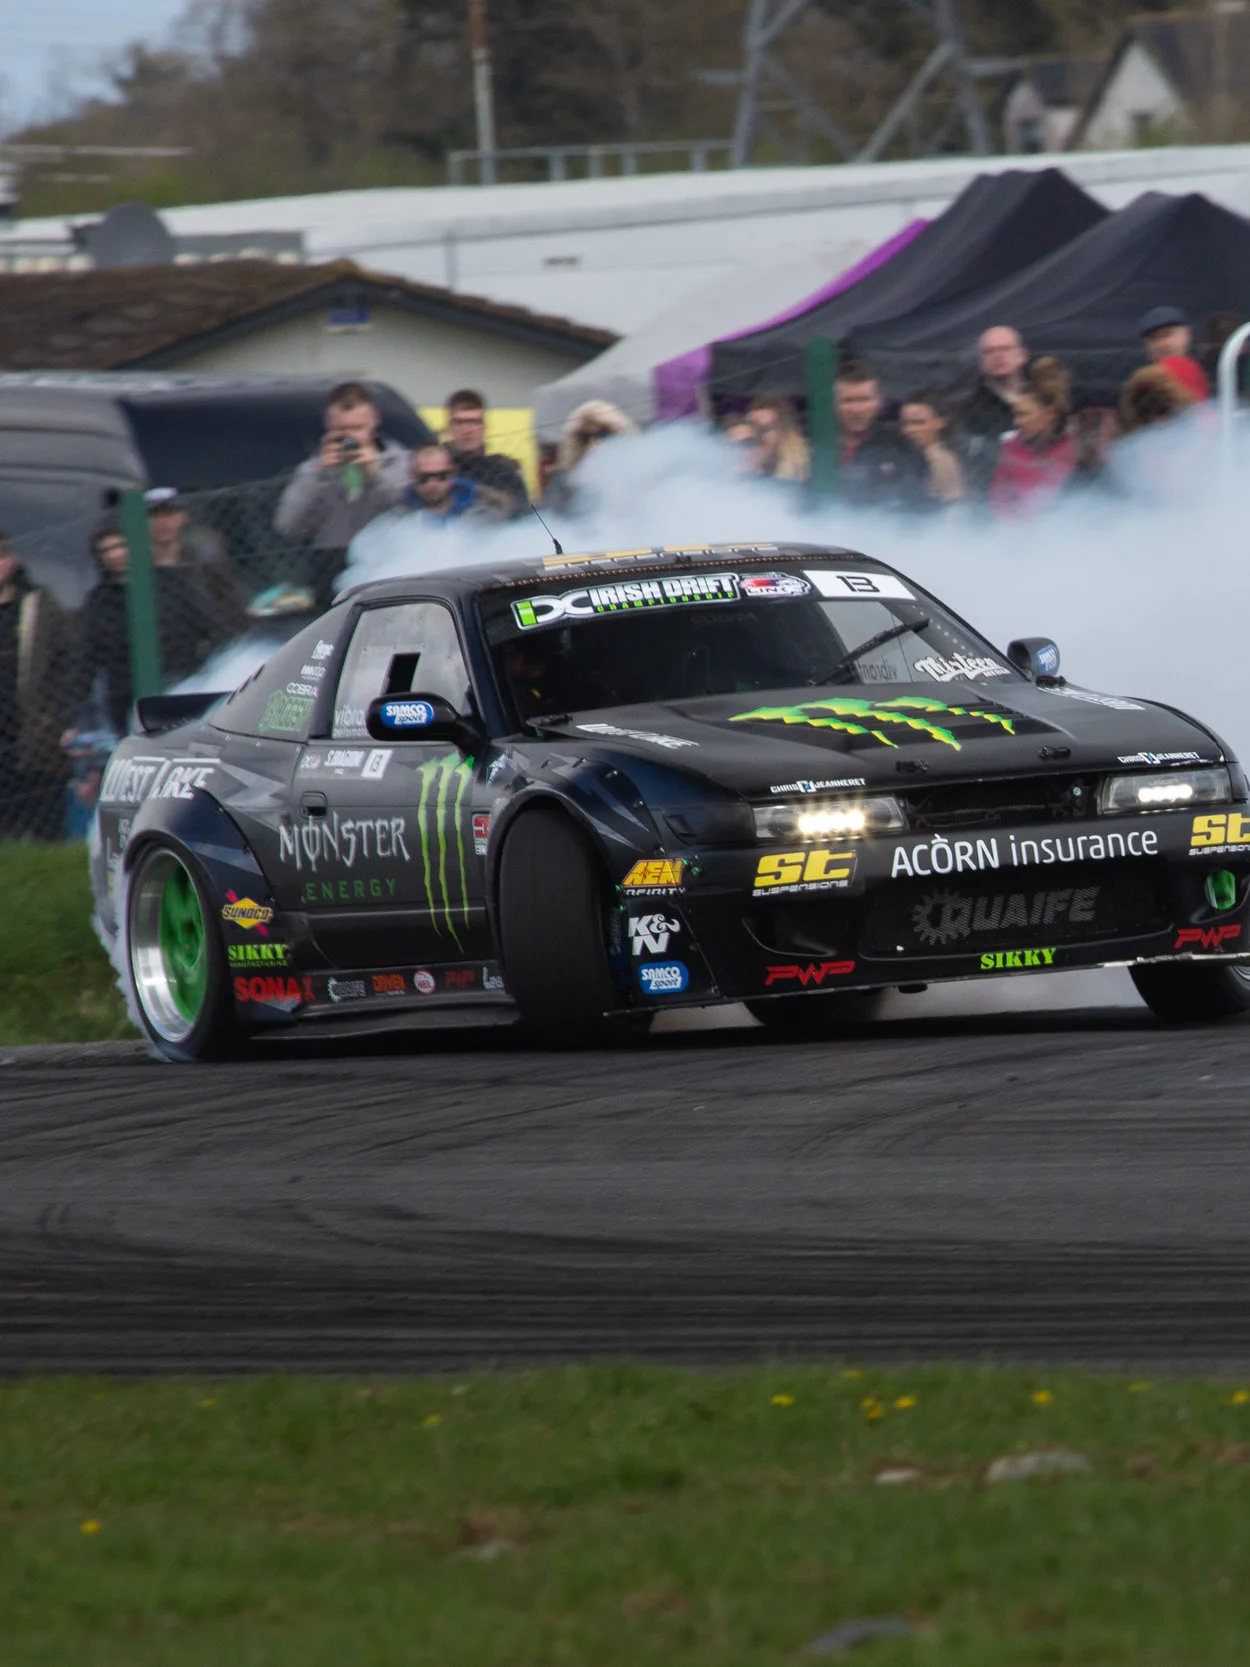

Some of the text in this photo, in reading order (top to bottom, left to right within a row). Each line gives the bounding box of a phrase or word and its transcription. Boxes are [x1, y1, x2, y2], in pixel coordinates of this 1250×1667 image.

[590, 578, 661, 606] IRISH
[662, 576, 735, 597] DRIFT
[836, 575, 880, 593] 13
[597, 592, 734, 612] CHAMPIONSHIP
[286, 682, 318, 698] COBRA
[386, 704, 427, 717] SAMCO
[770, 782, 800, 794] CHRIS
[814, 778, 866, 790] JEANNERET
[1009, 830, 1159, 867] insurance
[622, 859, 683, 887] AEM
[305, 878, 396, 901] ENERGY
[222, 905, 273, 922] SUNOCO
[911, 886, 1099, 946] QUAIFE
[1174, 924, 1242, 949] PWP
[228, 944, 286, 961] SIKKY
[980, 948, 1056, 970] SIKKY
[641, 966, 681, 981] SAMCO
[764, 960, 855, 986] PWP
[234, 976, 315, 1002] SONAX
